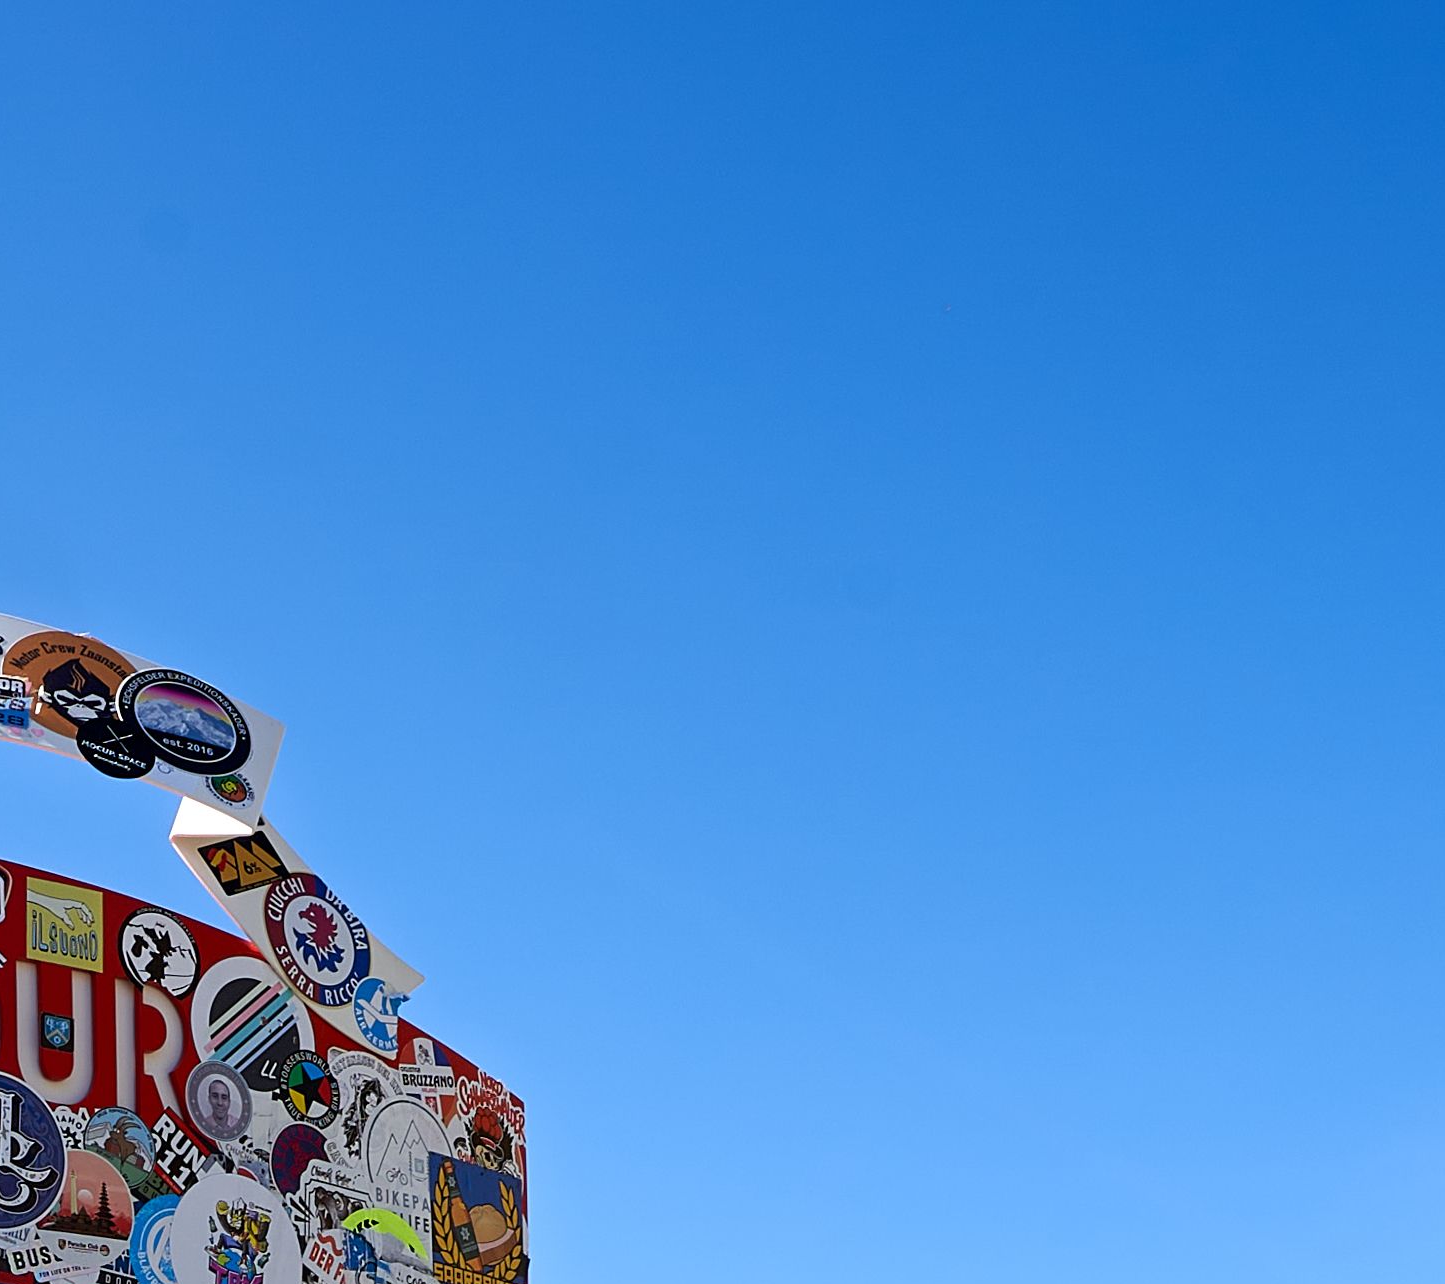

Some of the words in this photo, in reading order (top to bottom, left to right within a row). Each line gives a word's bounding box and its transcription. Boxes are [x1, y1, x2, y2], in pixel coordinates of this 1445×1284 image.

[11, 644, 42, 671] Motor
[41, 640, 76, 657] Crew
[162, 737, 185, 749] est.
[268, 876, 306, 922] CIUCCHI
[343, 904, 369, 951] BIRA
[275, 944, 315, 1001] SERRA
[354, 1007, 369, 1032] AIR
[402, 1072, 455, 1089] BRUZZANO
[152, 1113, 209, 1174] RUN
[309, 1241, 336, 1275] DER
